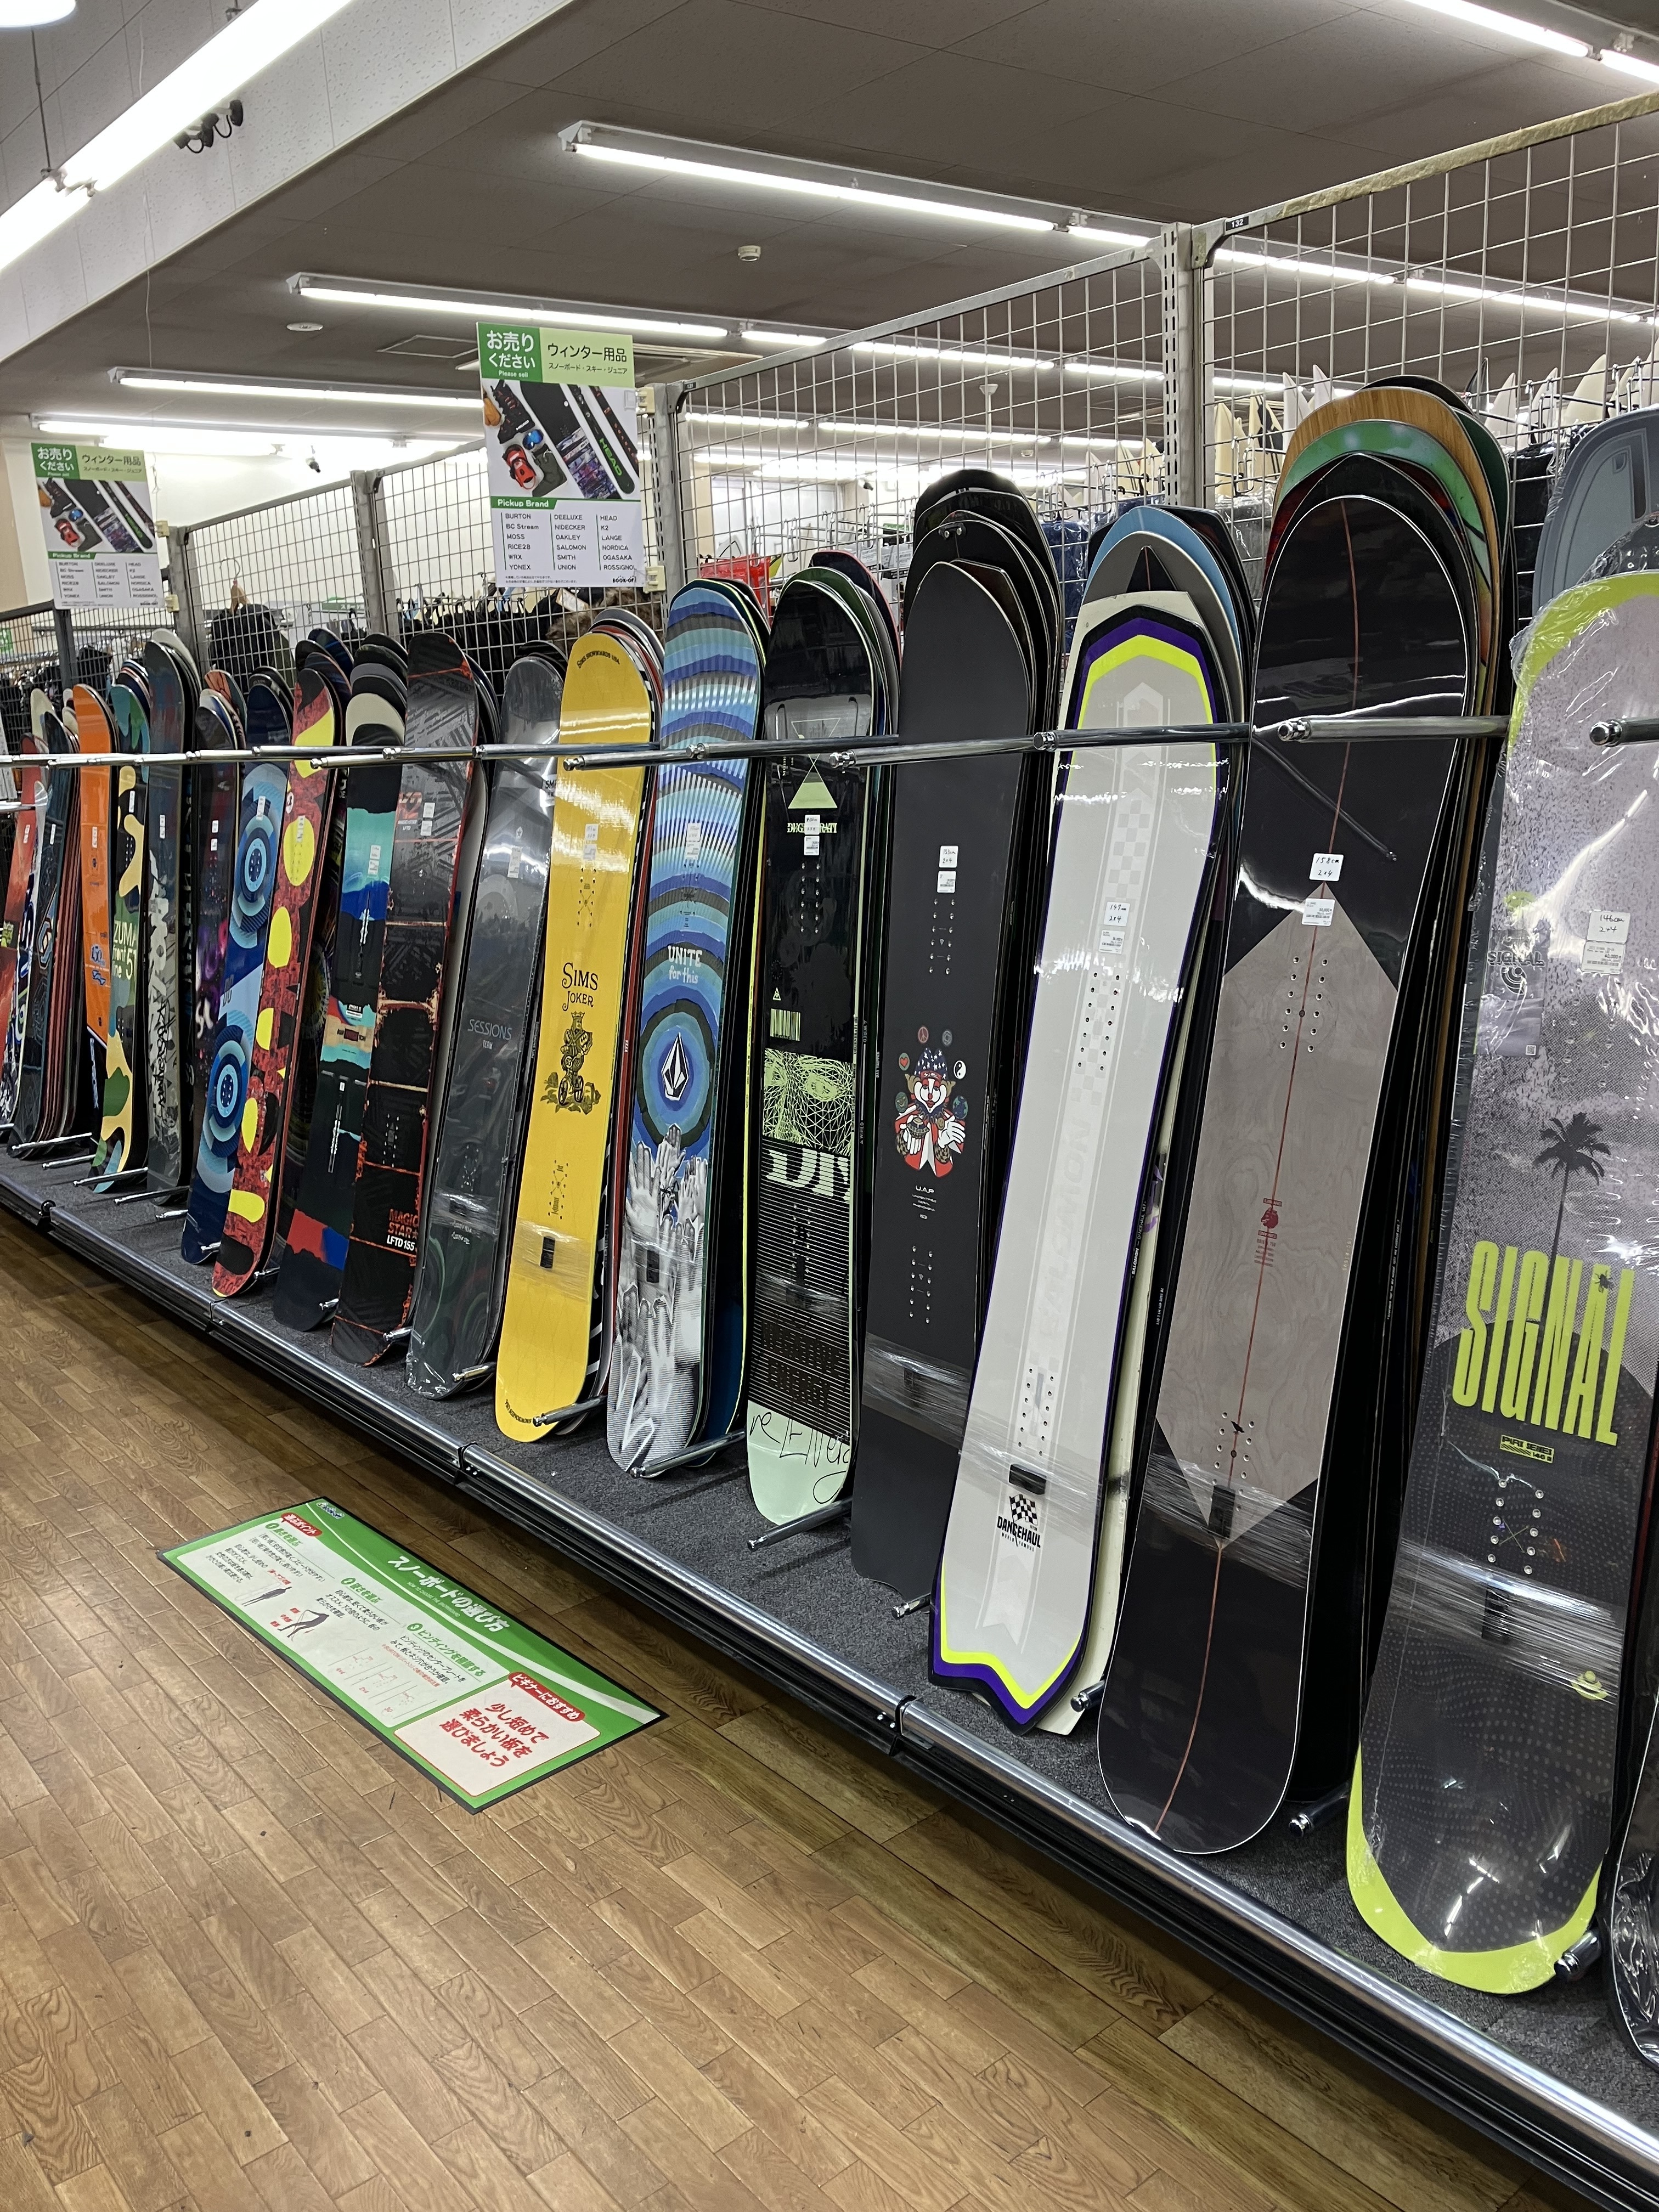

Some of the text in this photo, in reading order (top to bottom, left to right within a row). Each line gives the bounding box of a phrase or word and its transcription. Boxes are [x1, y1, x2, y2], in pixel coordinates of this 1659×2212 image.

[1231, 218, 1244, 228] 132
[487, 330, 534, 352] お売り
[488, 353, 535, 369] ください
[548, 343, 627, 362] ウィンター用品
[37, 447, 72, 461] お売り
[82, 454, 141, 466] ウィンター用品
[40, 461, 74, 471] ください
[668, 945, 702, 967] UNITE
[562, 962, 599, 991] SIMS
[669, 965, 698, 984] for this
[562, 990, 594, 1011] JOKER
[467, 1019, 512, 1041] SESSIONS
[387, 1222, 412, 1239] STAR
[386, 1234, 415, 1251] LFTD 155
[1131, 1248, 1139, 1276] SALOMON
[1452, 1239, 1635, 1447] SIGNAL
[997, 1515, 1041, 1548] DANCEHAUL
[388, 1556, 510, 1632] スノーボードの選び方
[513, 1673, 580, 1719] ビギナーにおすすめ
[459, 1708, 533, 1758] 柔らかい板を
[485, 1703, 550, 1743] 少し短めで
[439, 1718, 509, 1767] 選びましょう
